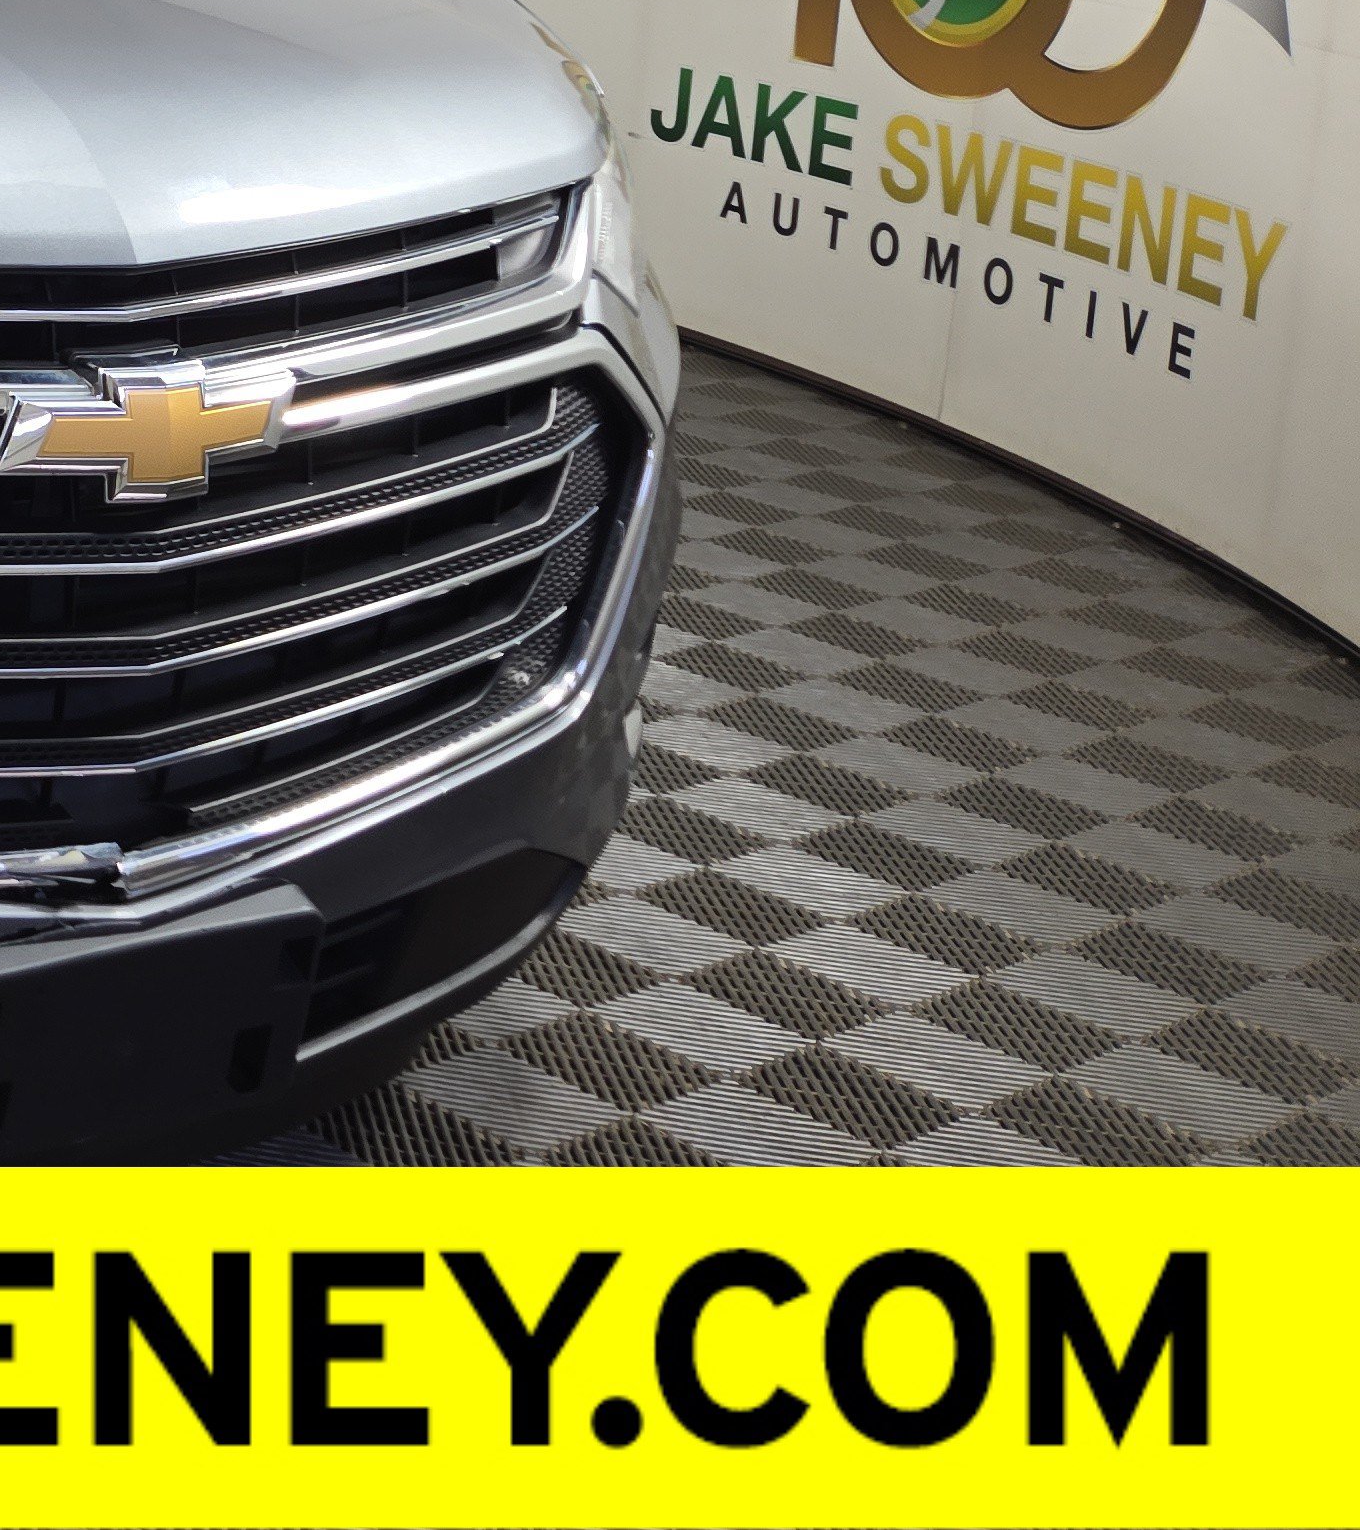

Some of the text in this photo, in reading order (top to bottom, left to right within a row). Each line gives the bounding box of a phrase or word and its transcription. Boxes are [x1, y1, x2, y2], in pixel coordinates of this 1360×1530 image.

[650, 67, 1288, 323] JAKE SWEENEY
[720, 180, 1197, 380] AUTOMOTIVE
